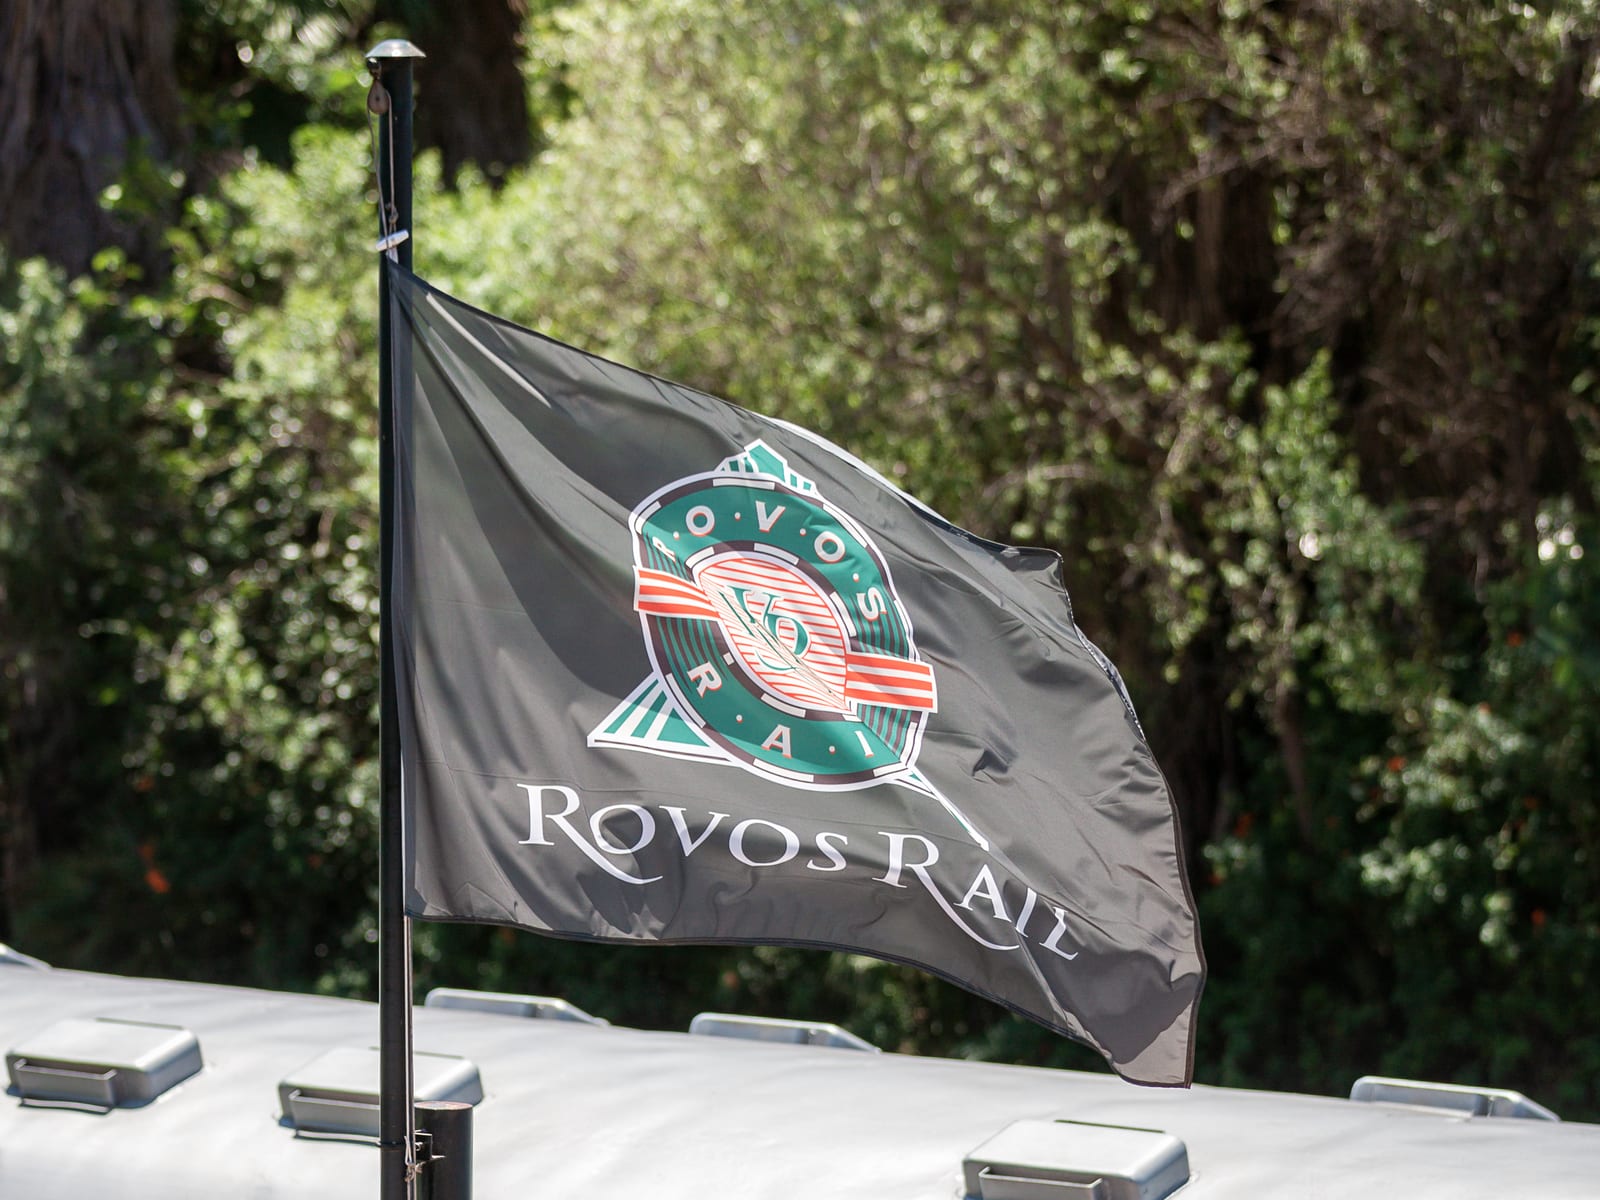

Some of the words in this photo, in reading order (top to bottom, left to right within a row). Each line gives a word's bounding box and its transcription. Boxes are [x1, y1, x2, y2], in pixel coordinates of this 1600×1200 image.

[687, 660, 874, 759] RAI
[516, 783, 849, 885] ROVOS
[872, 830, 1079, 961] RAIL
